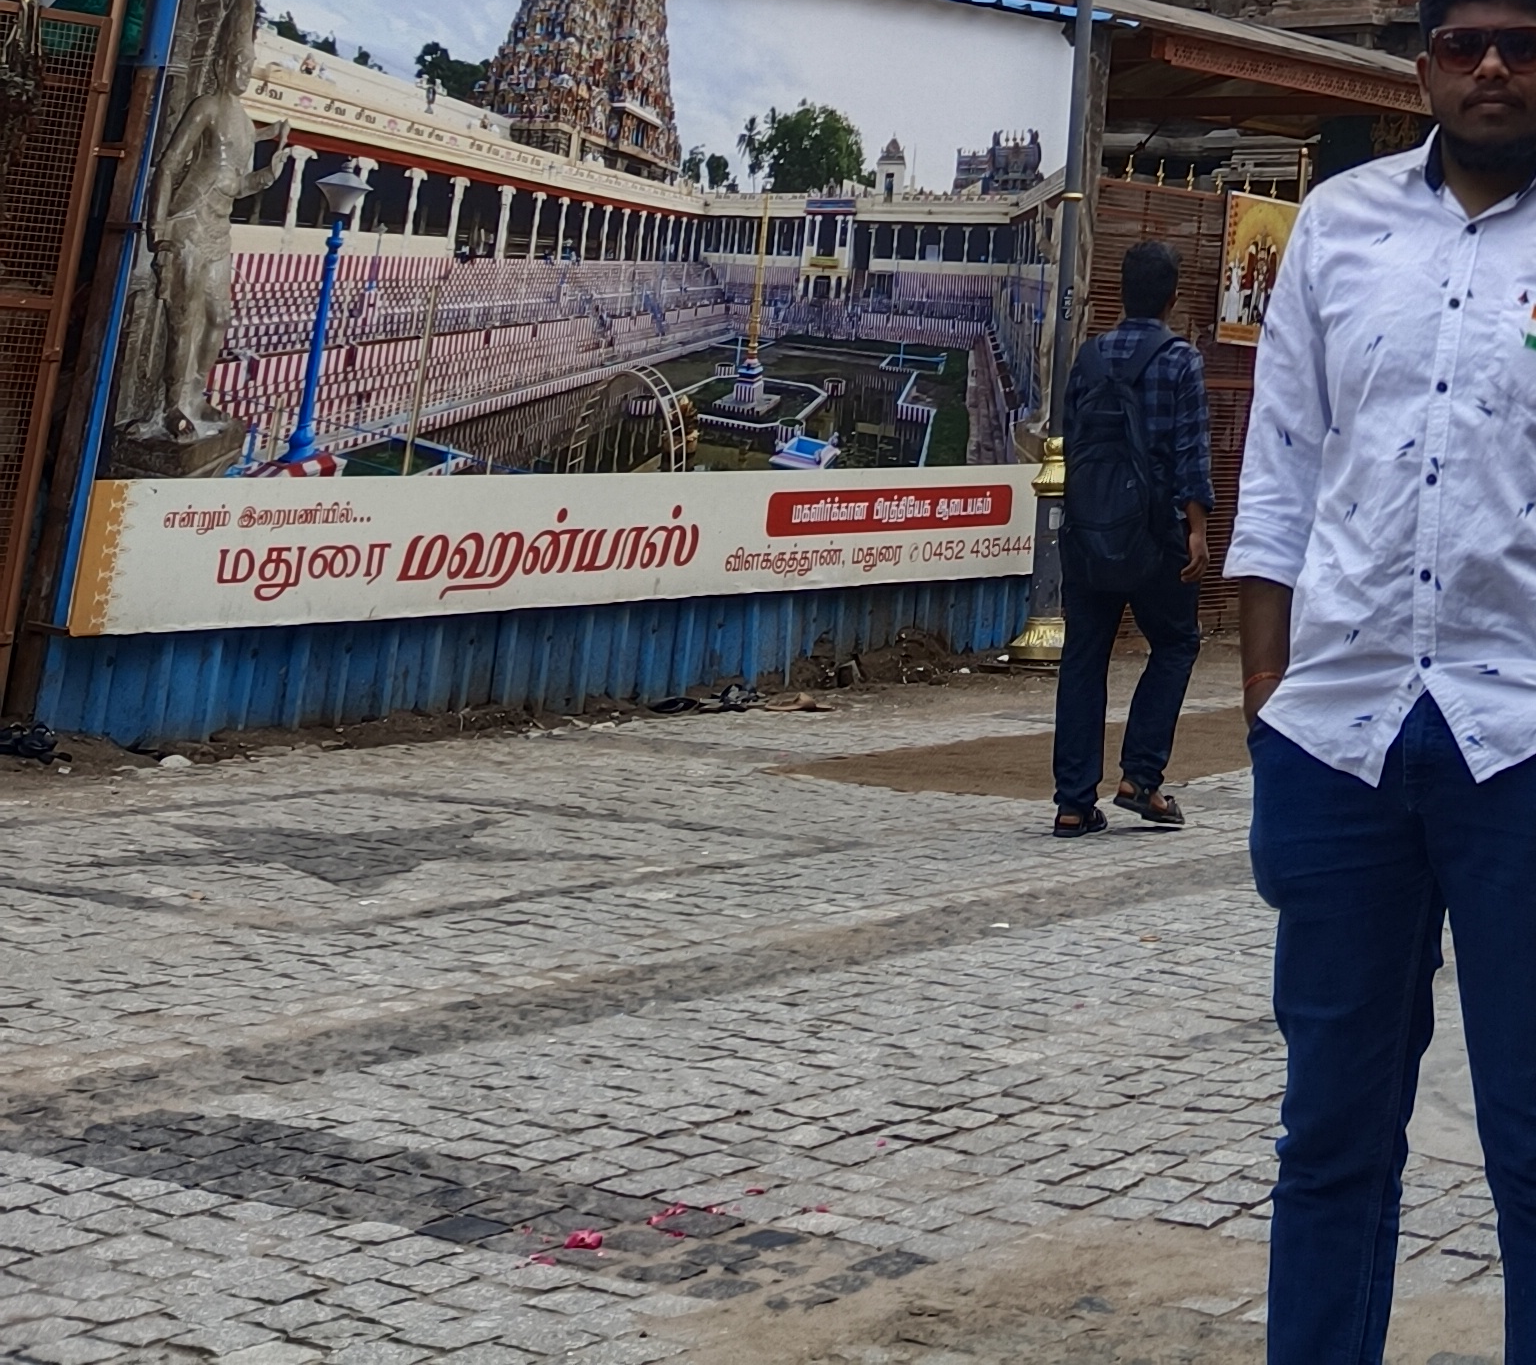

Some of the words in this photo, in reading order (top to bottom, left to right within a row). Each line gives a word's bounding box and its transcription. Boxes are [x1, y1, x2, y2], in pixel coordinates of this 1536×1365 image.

[163, 504, 231, 535] என்றும்
[216, 542, 391, 601] மதுரை
[851, 544, 903, 573] மதுரை
[921, 539, 966, 562] 0452
